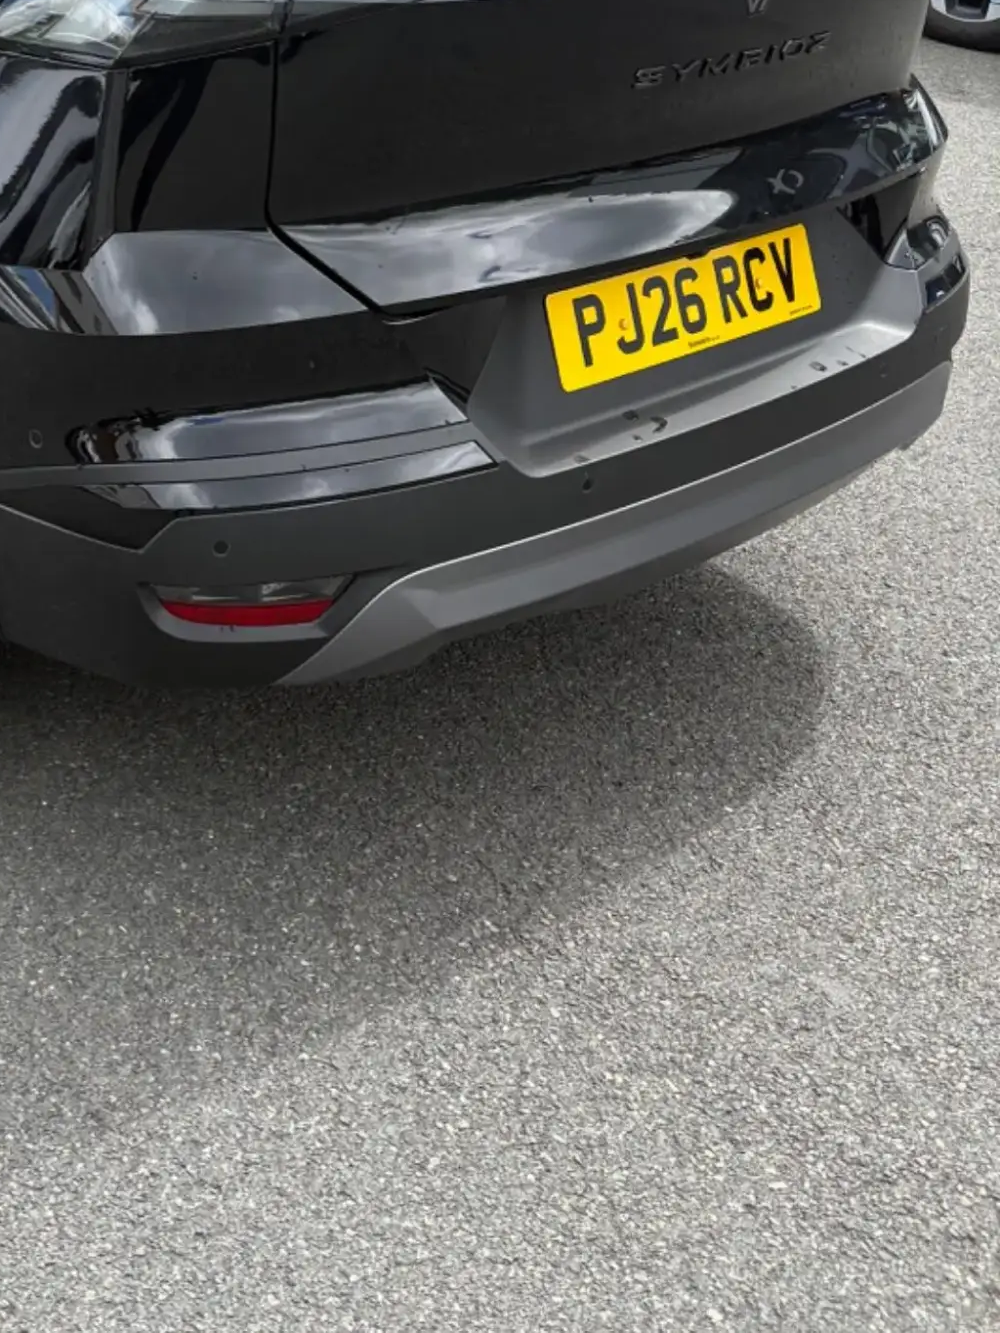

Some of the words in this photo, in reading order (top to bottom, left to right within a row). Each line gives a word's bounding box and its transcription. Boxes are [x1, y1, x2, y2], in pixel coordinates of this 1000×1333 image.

[631, 30, 831, 90] SYMBIOZ
[572, 266, 707, 367] PJ26
[712, 237, 796, 323] RCV
